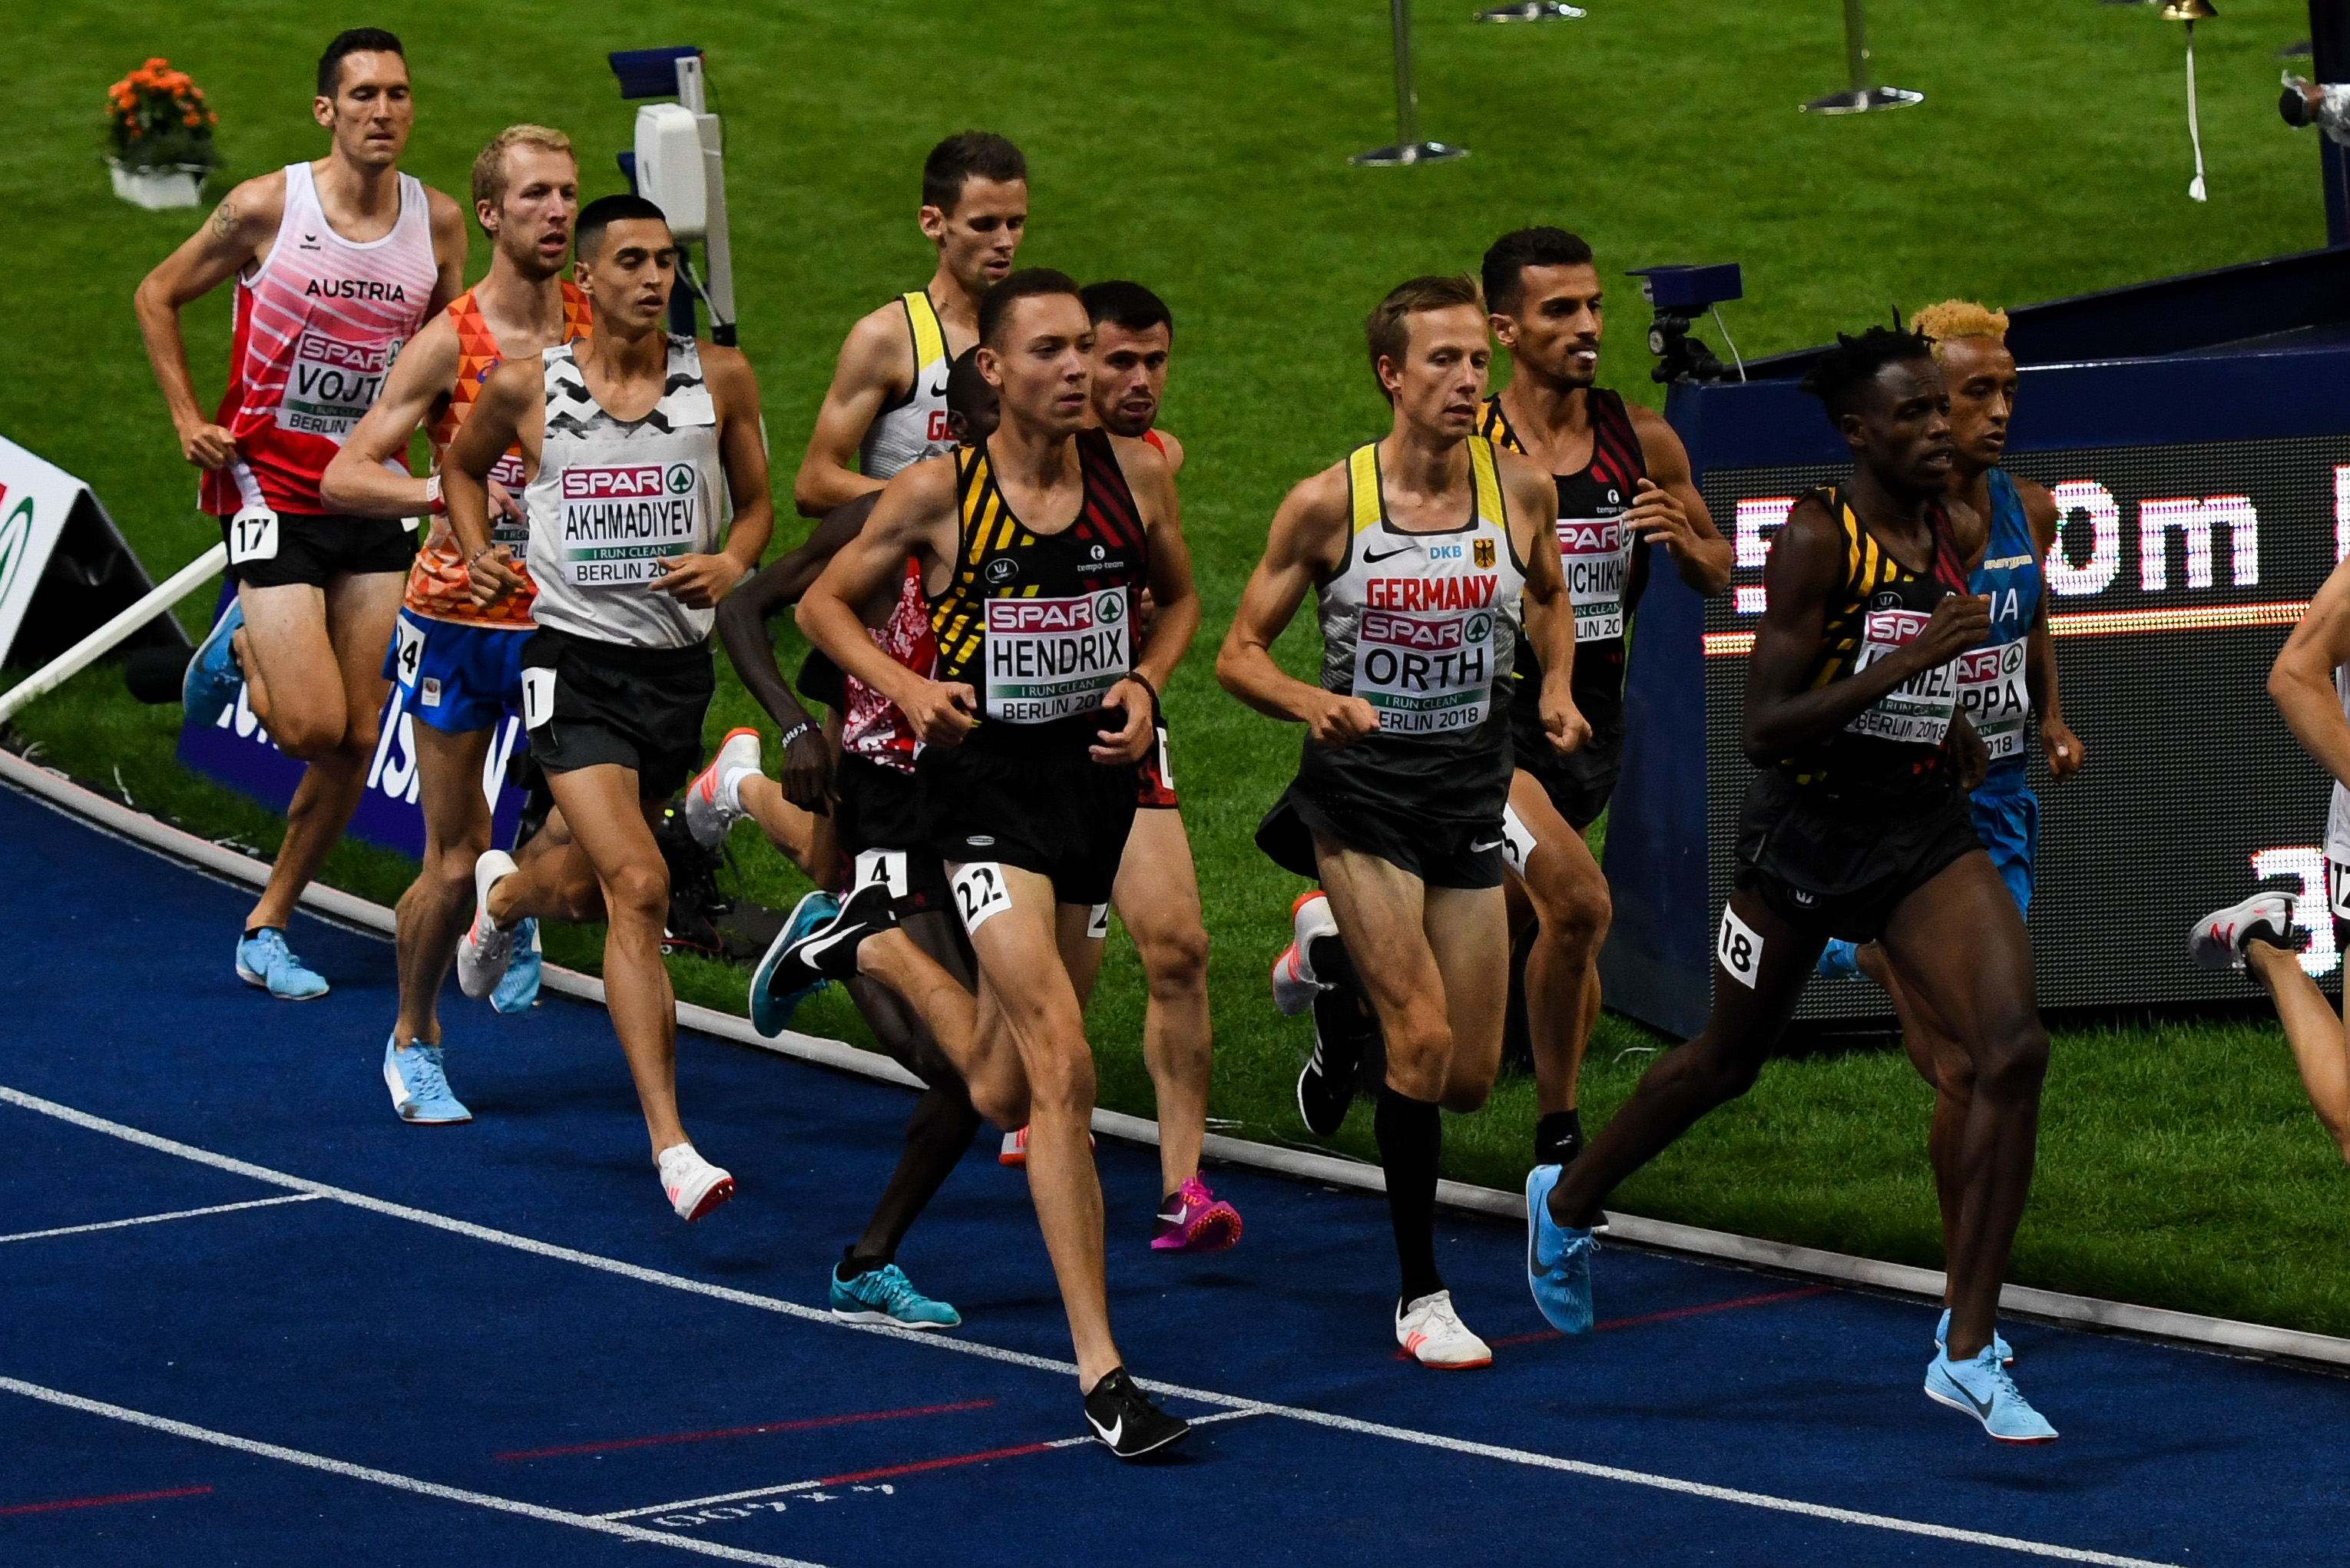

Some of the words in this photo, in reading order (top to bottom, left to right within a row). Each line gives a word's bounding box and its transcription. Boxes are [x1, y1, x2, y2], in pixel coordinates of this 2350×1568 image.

[305, 280, 405, 303] AUSTRIA
[303, 337, 383, 370] SPAR
[298, 364, 387, 405] VOJT
[290, 414, 346, 434] BERLIN
[564, 471, 662, 495] SPAR
[565, 498, 694, 541] AKHMADIYEV
[237, 518, 270, 553] 17
[1557, 525, 1620, 550] PAR
[594, 549, 597, 559] I
[601, 547, 626, 559] RUN
[1430, 545, 1462, 560] DKB
[577, 562, 641, 581] BERLIN
[648, 563, 668, 577] 20
[1366, 574, 1498, 611] GERMANY
[992, 601, 1091, 629] SPAR
[1365, 617, 1460, 646] SPAR
[1575, 620, 1600, 639] LIN
[1604, 619, 1620, 635] 20
[992, 628, 1124, 677] HENDRIX
[1365, 647, 1484, 691] ORTH
[1958, 655, 1998, 679] AR
[528, 679, 535, 717] 1
[1021, 686, 1025, 696] I
[1029, 684, 1055, 696] RUN
[1385, 695, 1390, 704] I
[1393, 696, 1419, 710] RUN
[1963, 679, 2022, 719] PPA
[1003, 699, 1069, 720] BERLIN
[1075, 693, 1104, 711] 201
[1379, 711, 1432, 730] ERLIN
[1439, 706, 1479, 729] 2018
[1886, 701, 1911, 711] RUN
[870, 855, 891, 883] 4
[957, 867, 1003, 924] 22
[1722, 918, 1753, 973] 18
